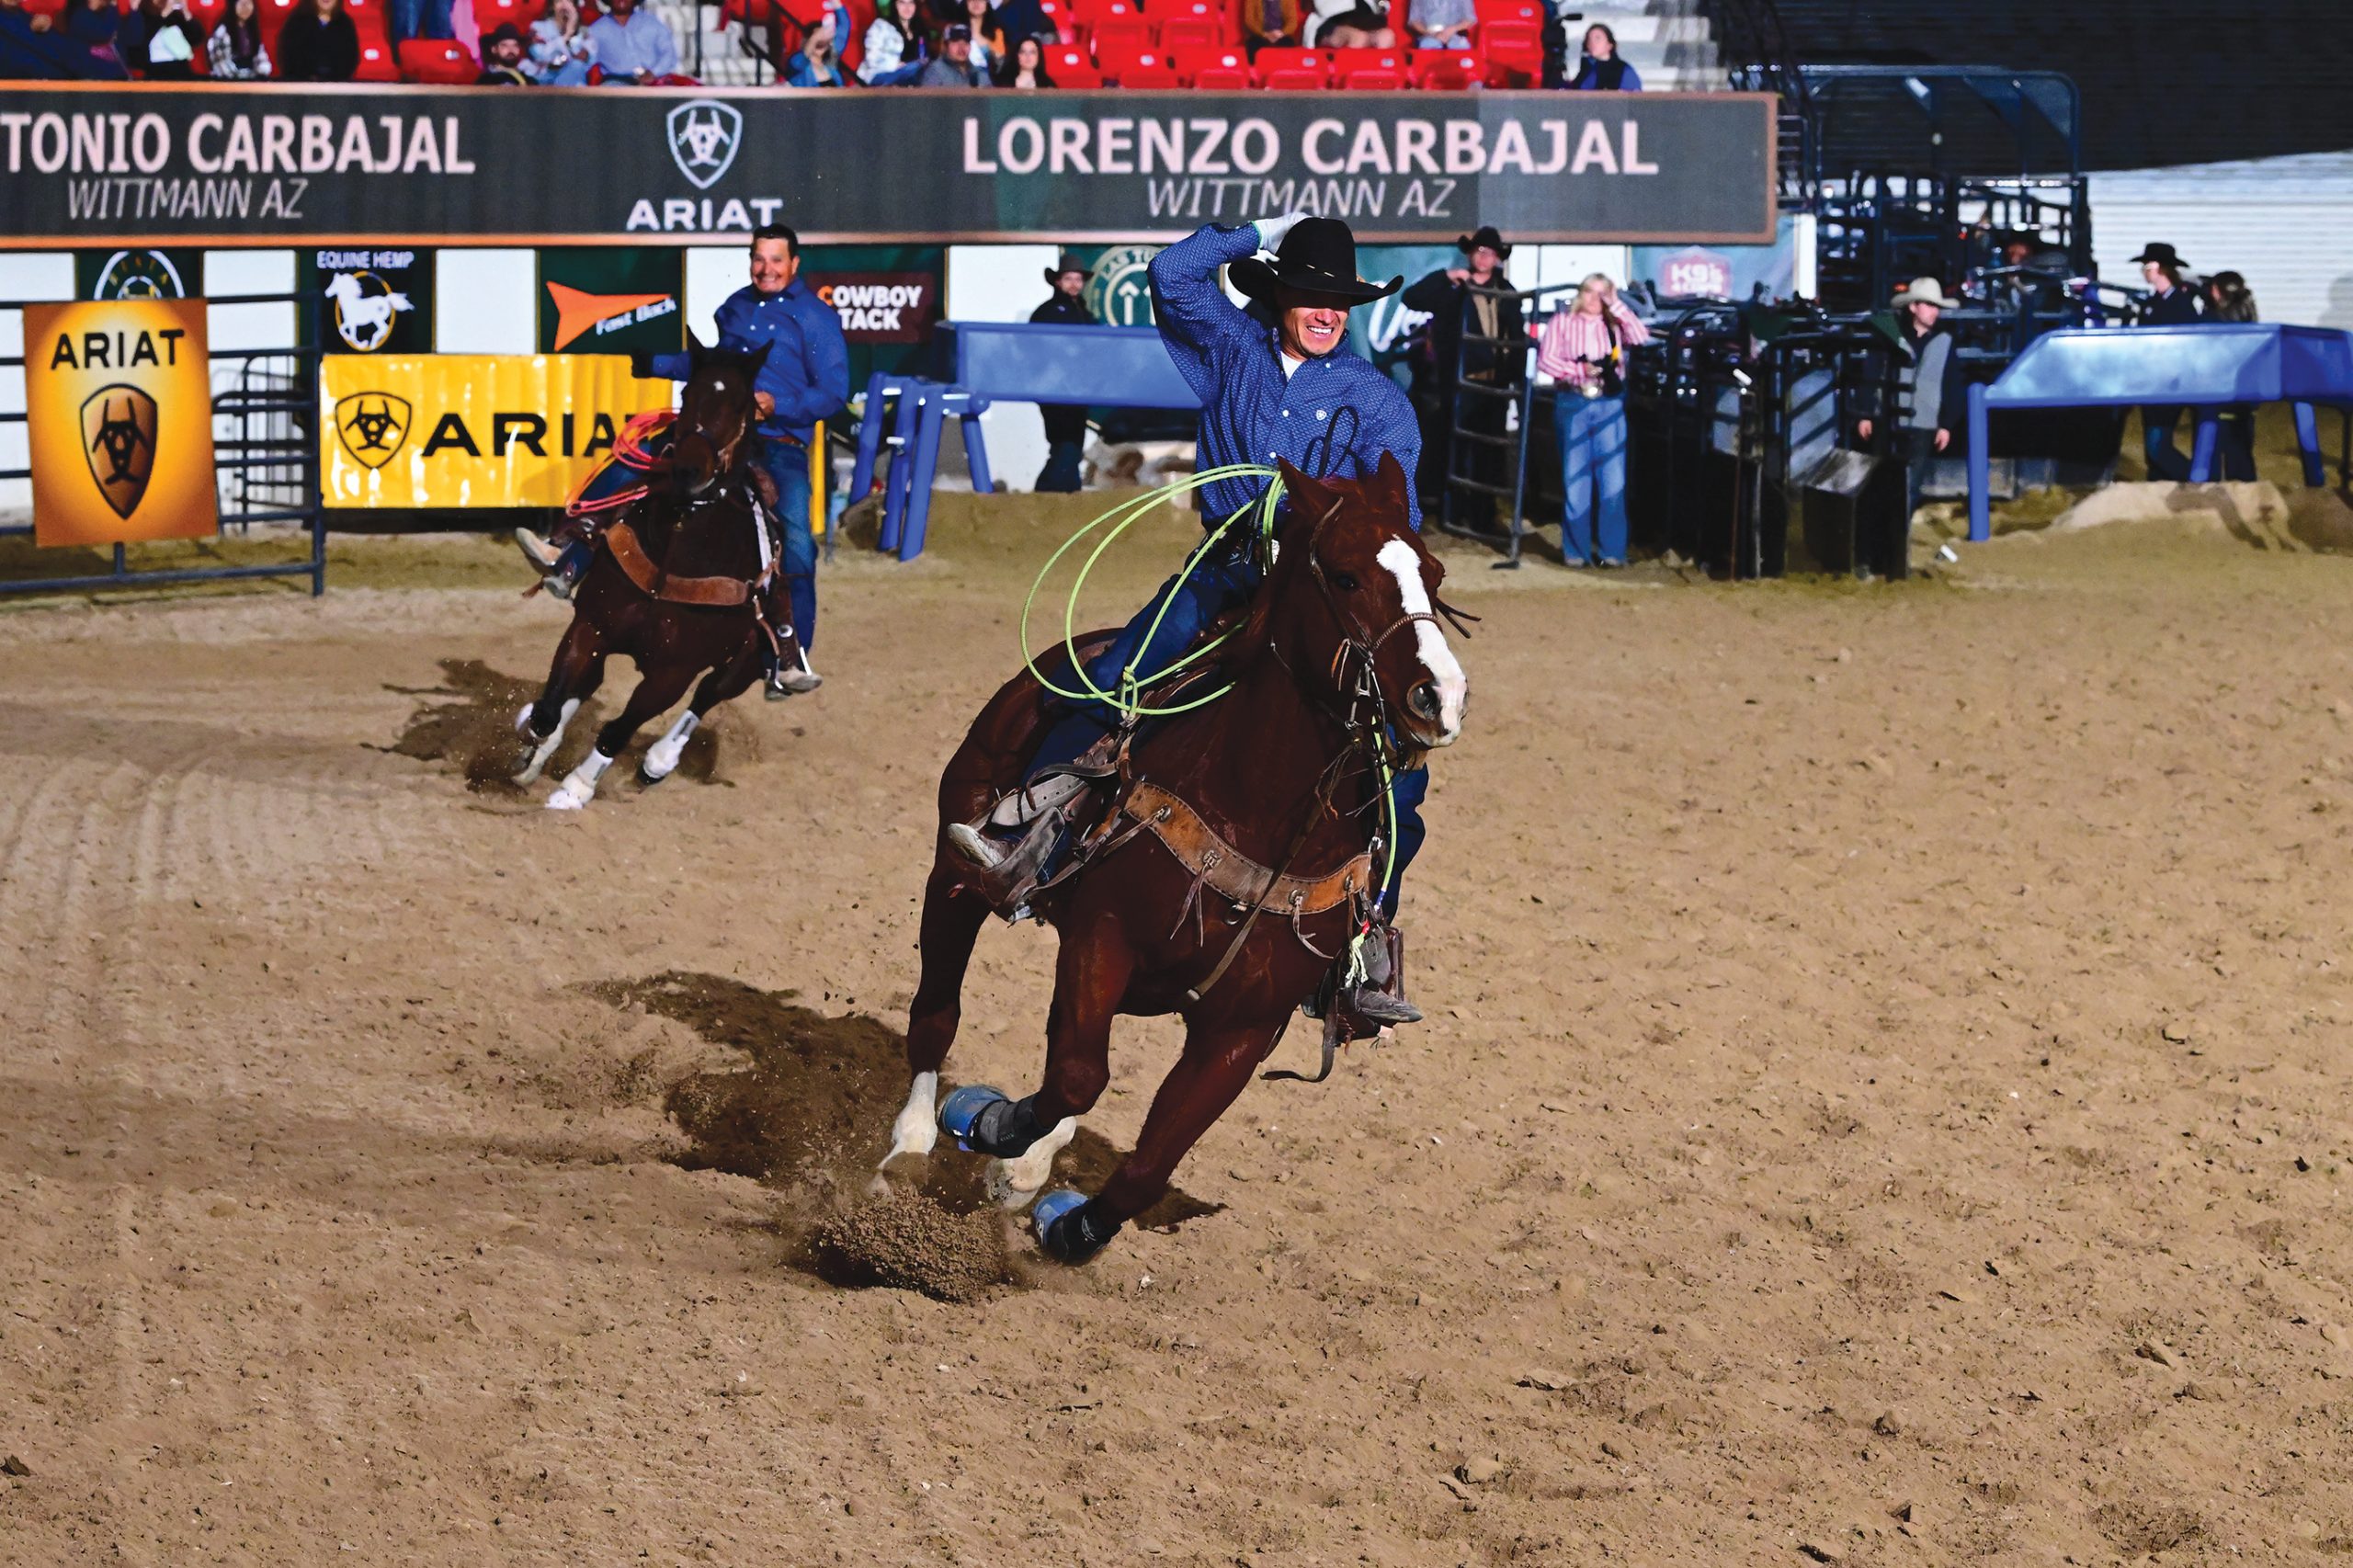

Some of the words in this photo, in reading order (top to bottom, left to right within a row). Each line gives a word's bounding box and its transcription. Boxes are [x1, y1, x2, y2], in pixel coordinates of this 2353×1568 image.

[0, 112, 169, 174] TONIO
[187, 113, 476, 174] CARBAJAL
[963, 117, 1281, 175] LORENZO
[1301, 119, 1660, 175] CARBAJAL
[68, 178, 253, 219] WITTMANN
[259, 178, 309, 219] AZ
[626, 198, 783, 231] ARIAT
[1148, 179, 1386, 218] WITTMANN
[1397, 179, 1457, 217] AZ
[316, 250, 370, 269] EQUINE
[372, 250, 415, 269] HEMP
[816, 285, 923, 308] COWBOY
[596, 312, 633, 336] Fast
[837, 307, 902, 331] TACK
[51, 328, 186, 370] ARIAT
[421, 413, 636, 458] ARIA
